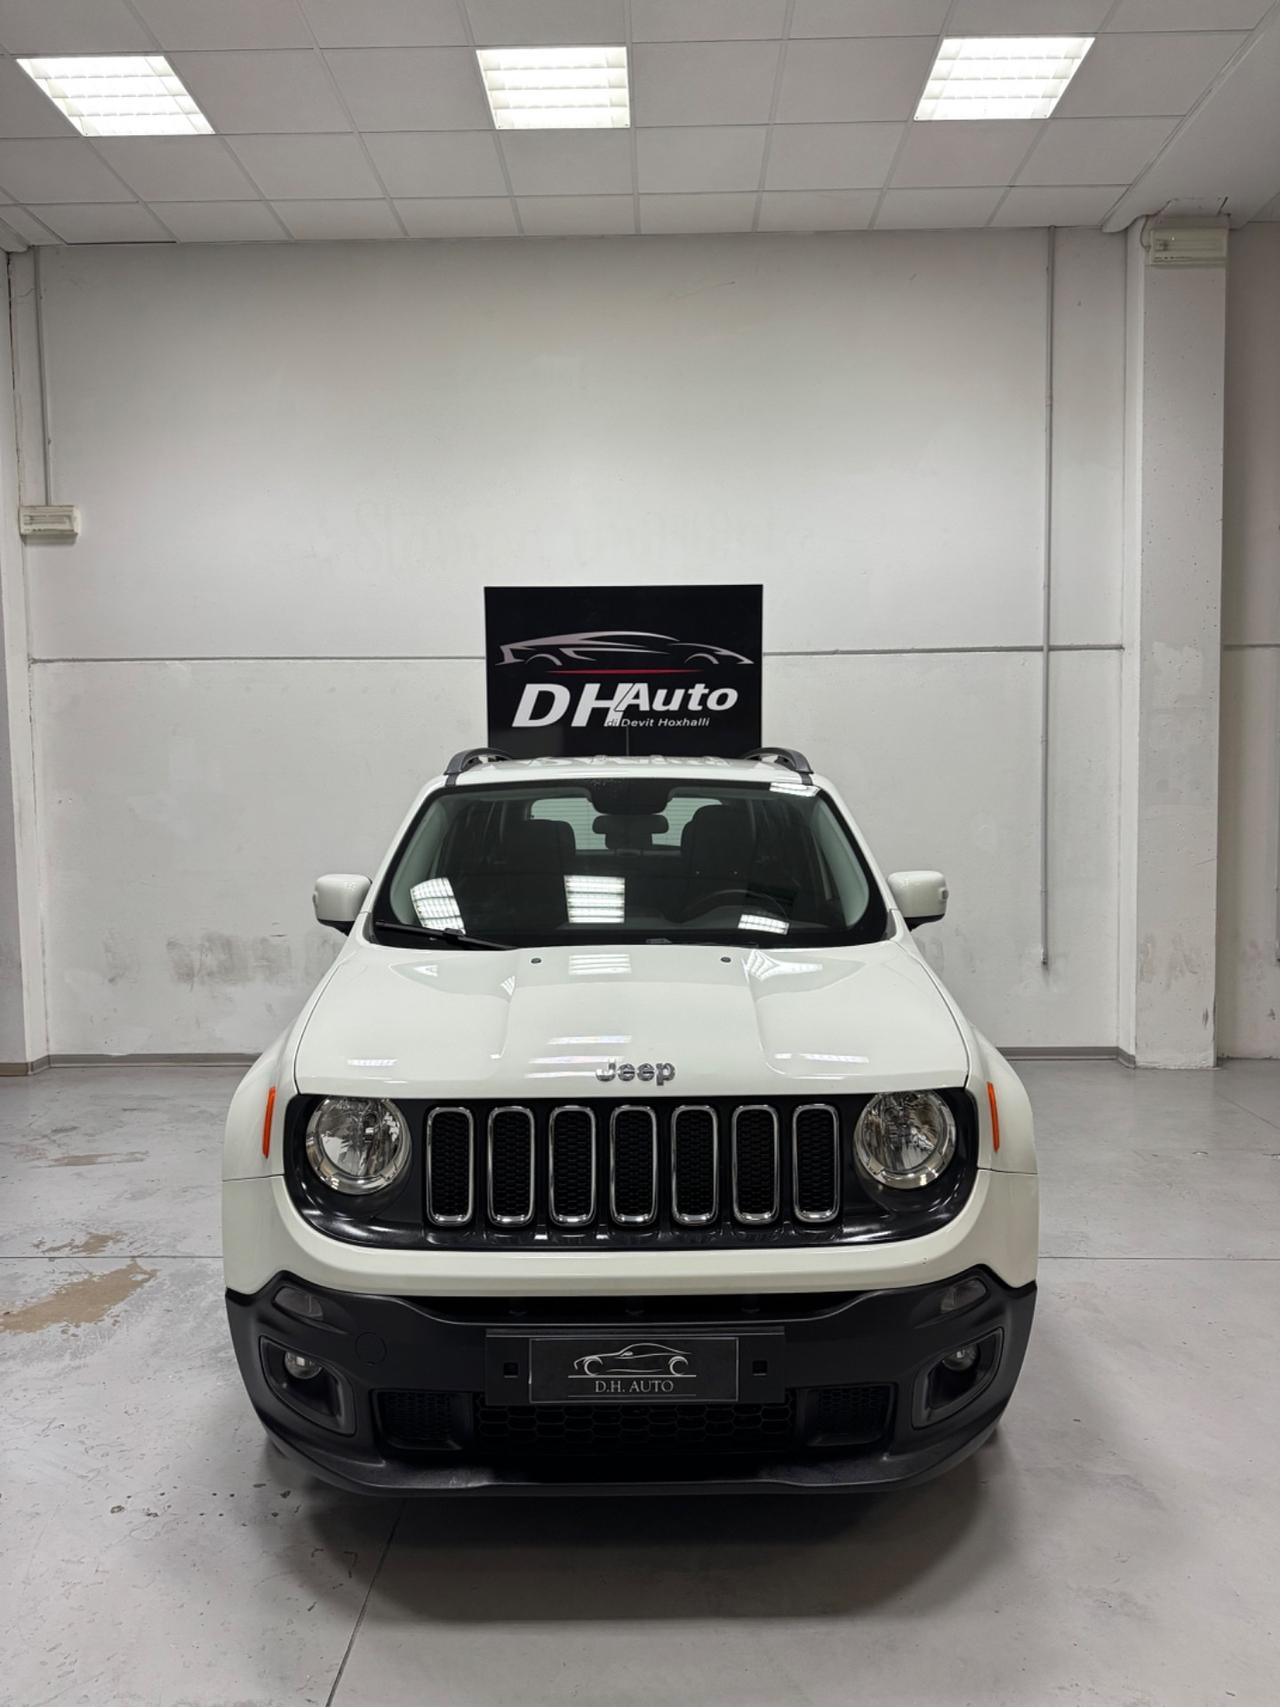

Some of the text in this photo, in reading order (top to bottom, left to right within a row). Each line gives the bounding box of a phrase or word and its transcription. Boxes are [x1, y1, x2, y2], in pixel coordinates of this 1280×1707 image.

[621, 717, 654, 727] Devit
[658, 717, 710, 727] Hoxhalli
[596, 1060, 676, 1086] Jeep
[595, 1380, 674, 1393] D.H. AUTO
